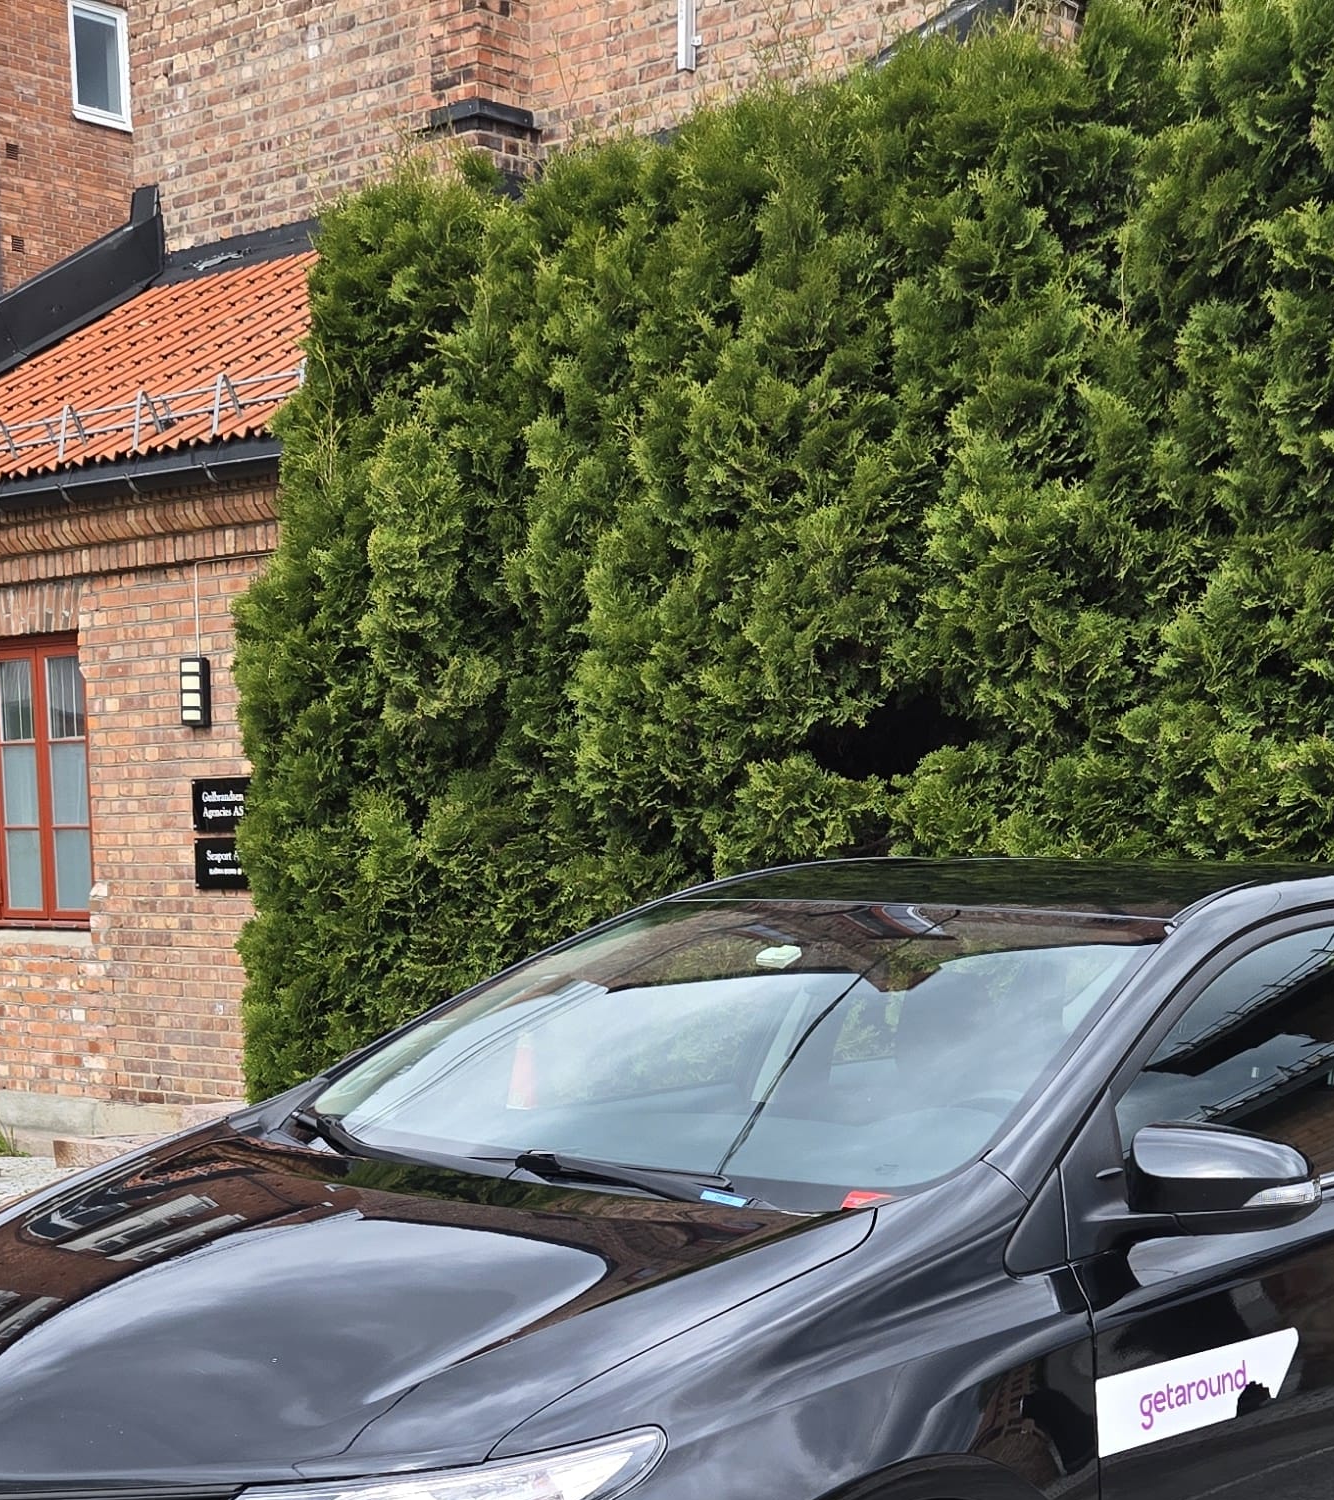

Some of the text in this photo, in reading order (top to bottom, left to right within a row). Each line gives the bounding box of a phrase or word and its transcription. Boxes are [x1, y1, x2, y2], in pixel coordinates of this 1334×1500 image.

[203, 805, 244, 819] Agencies AS
[1139, 1359, 1249, 1431] getaround
